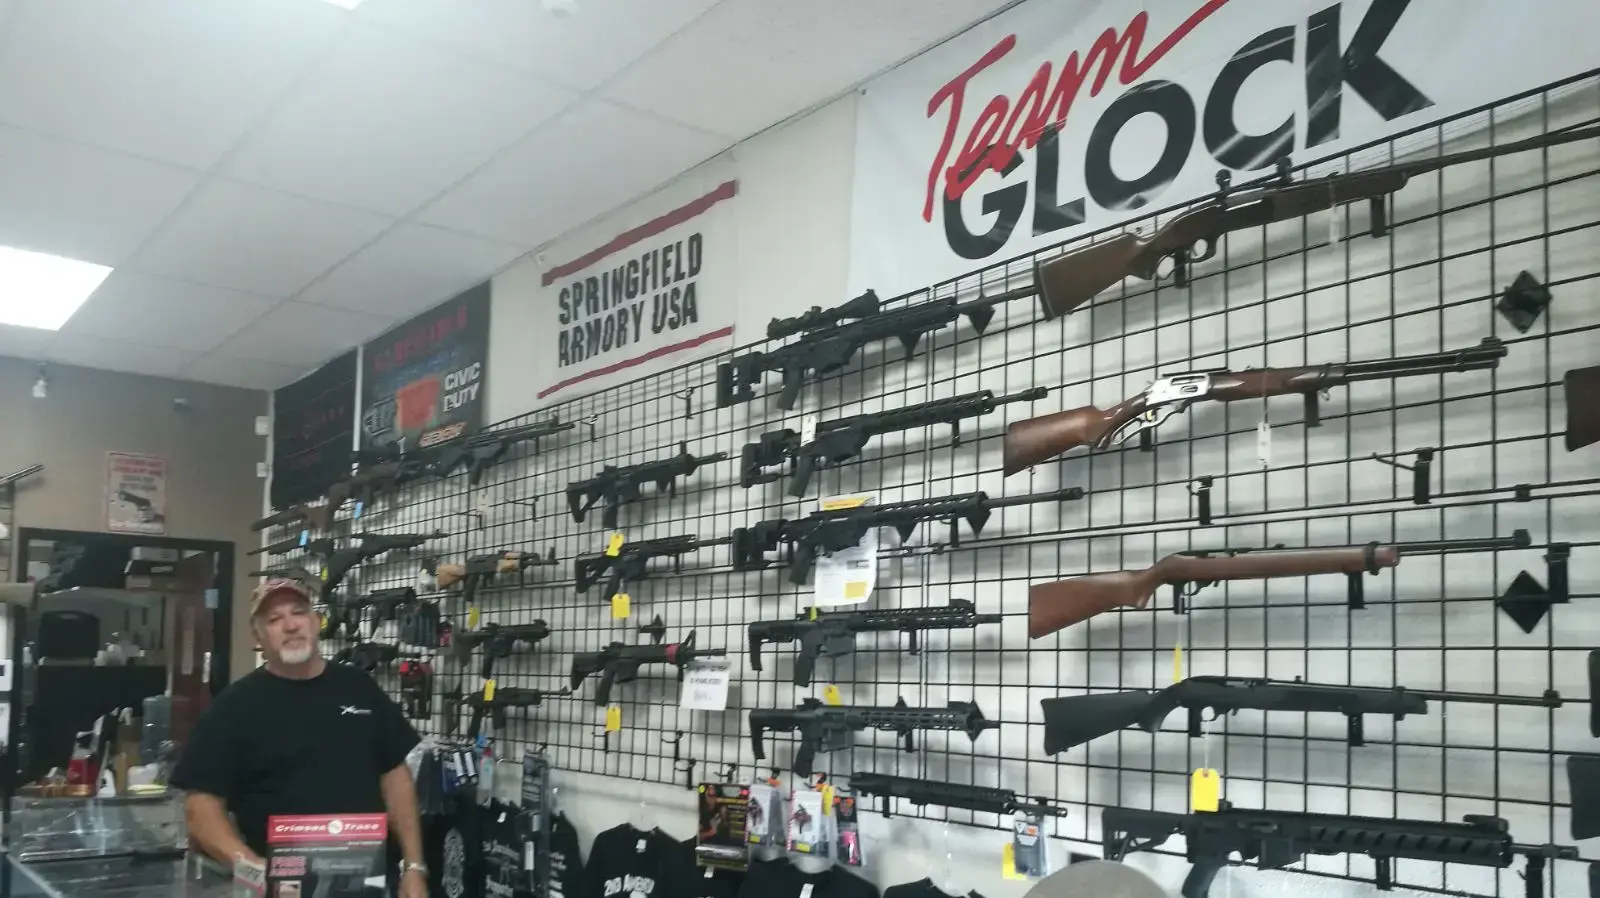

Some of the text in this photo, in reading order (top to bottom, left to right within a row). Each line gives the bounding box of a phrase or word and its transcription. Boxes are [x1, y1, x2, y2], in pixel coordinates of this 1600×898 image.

[922, 0, 1230, 223] Team
[943, 0, 1436, 260] GLOCK
[558, 232, 703, 326] SPRINGFIELD
[558, 281, 698, 368] ARMORY USA
[443, 382, 480, 412] DUTY
[445, 362, 481, 391] CIVIC
[275, 822, 380, 833] Crimson Trace
